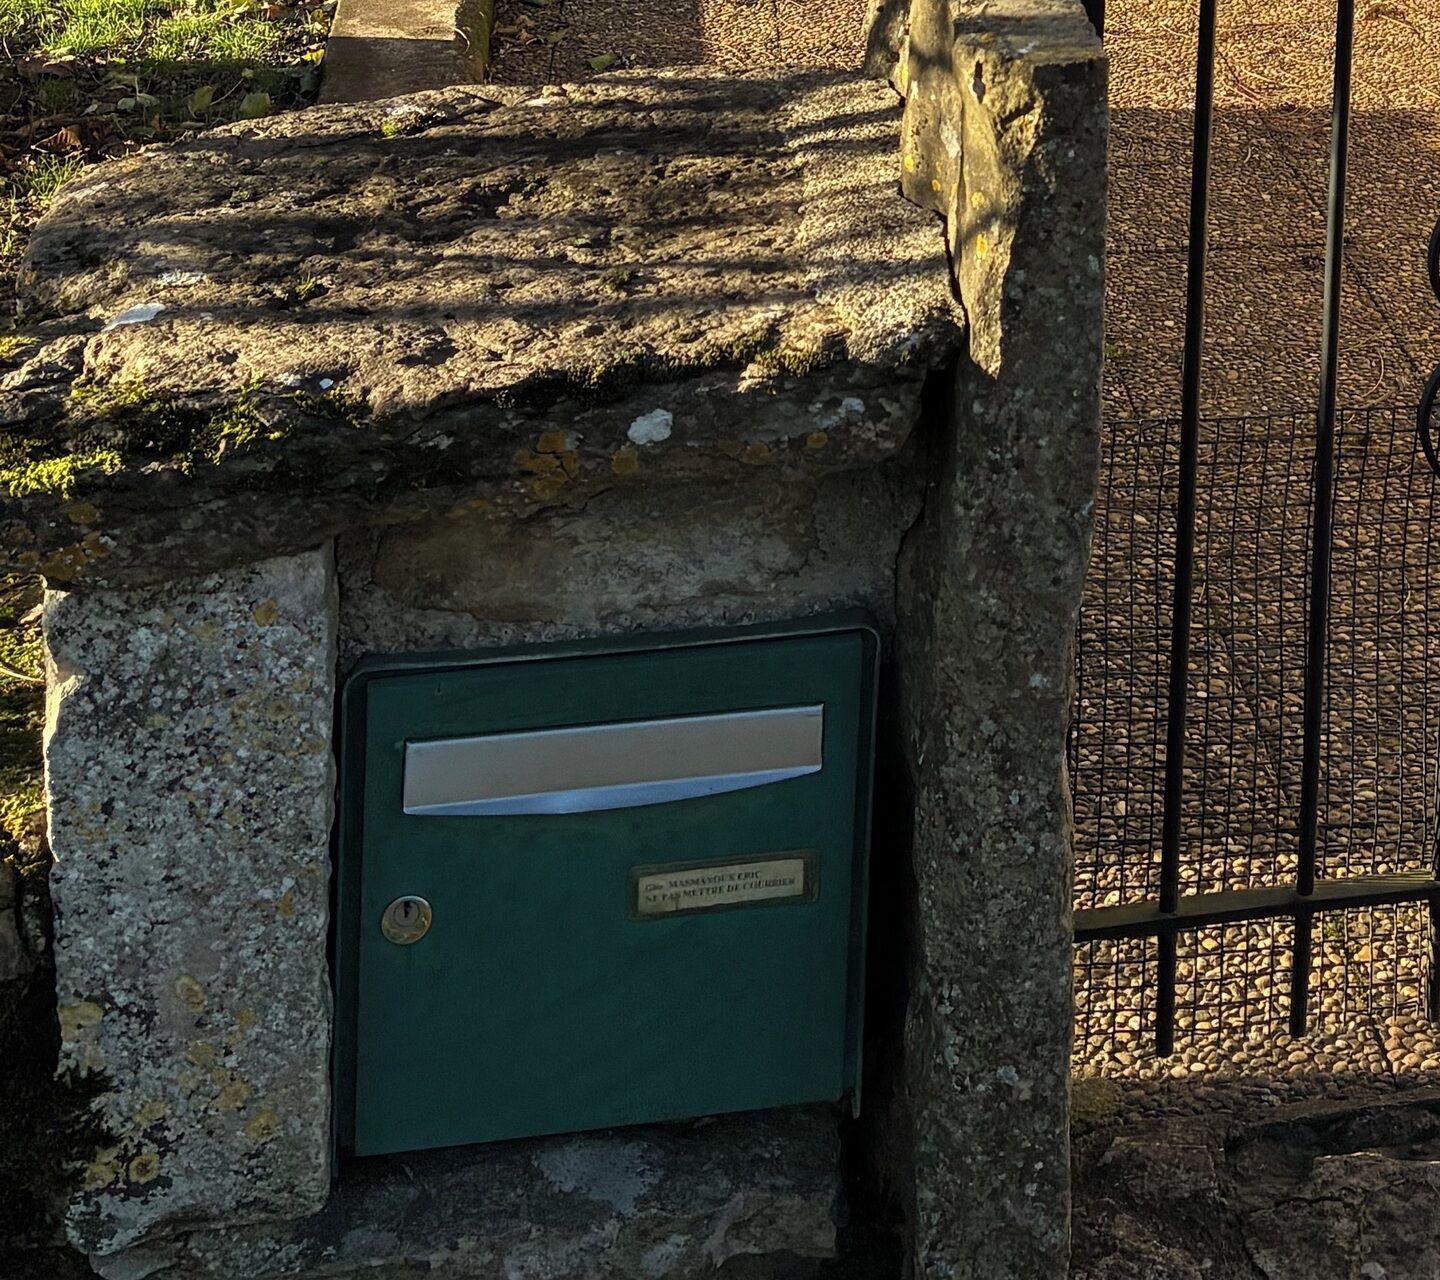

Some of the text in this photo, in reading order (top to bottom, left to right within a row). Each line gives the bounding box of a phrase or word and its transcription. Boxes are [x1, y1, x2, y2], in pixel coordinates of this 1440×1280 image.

[661, 890, 682, 902] PAS
[683, 885, 724, 898] METTRE
[726, 882, 739, 893] DE
[742, 877, 796, 891] COURRIER
